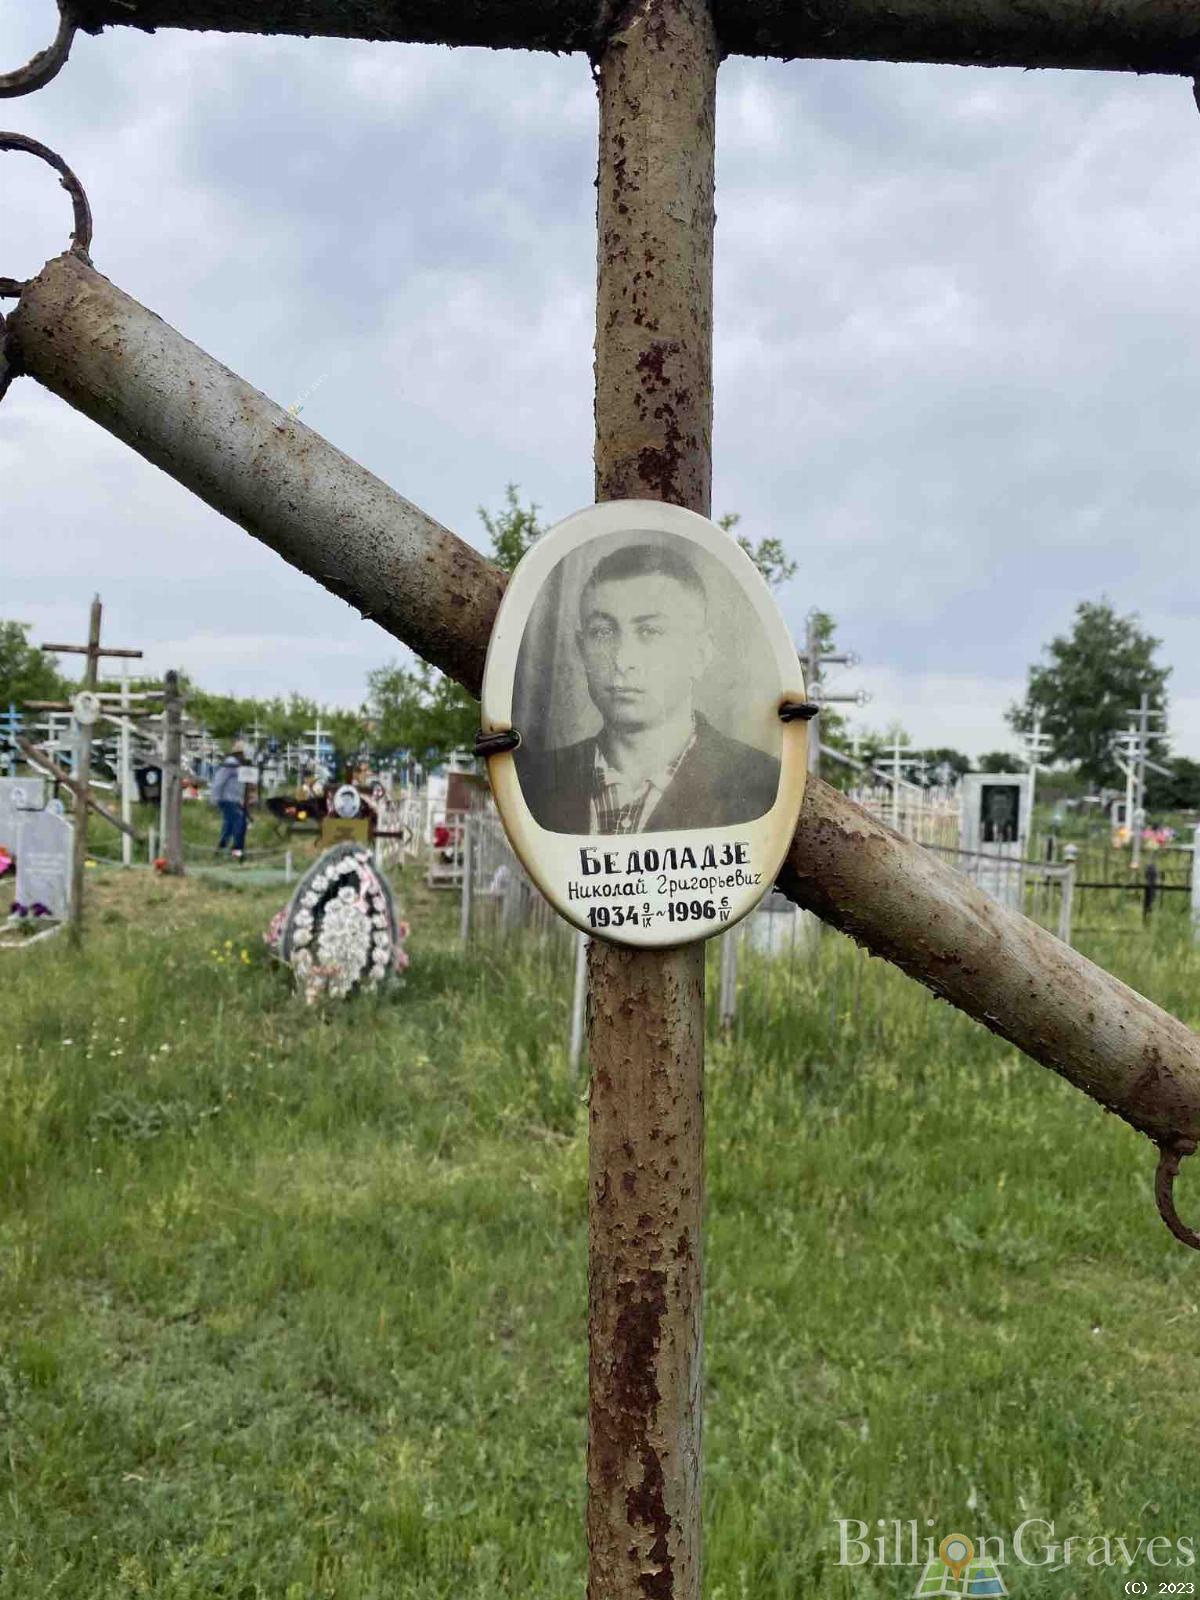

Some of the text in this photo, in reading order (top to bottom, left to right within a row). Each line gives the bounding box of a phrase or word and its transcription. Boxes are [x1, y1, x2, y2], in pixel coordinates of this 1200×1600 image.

[579, 842, 750, 876] БЕДОЛАДЗЕ
[568, 869, 762, 900] Николай Григорьевич
[587, 906, 639, 928] 1934
[668, 900, 717, 922] 1996
